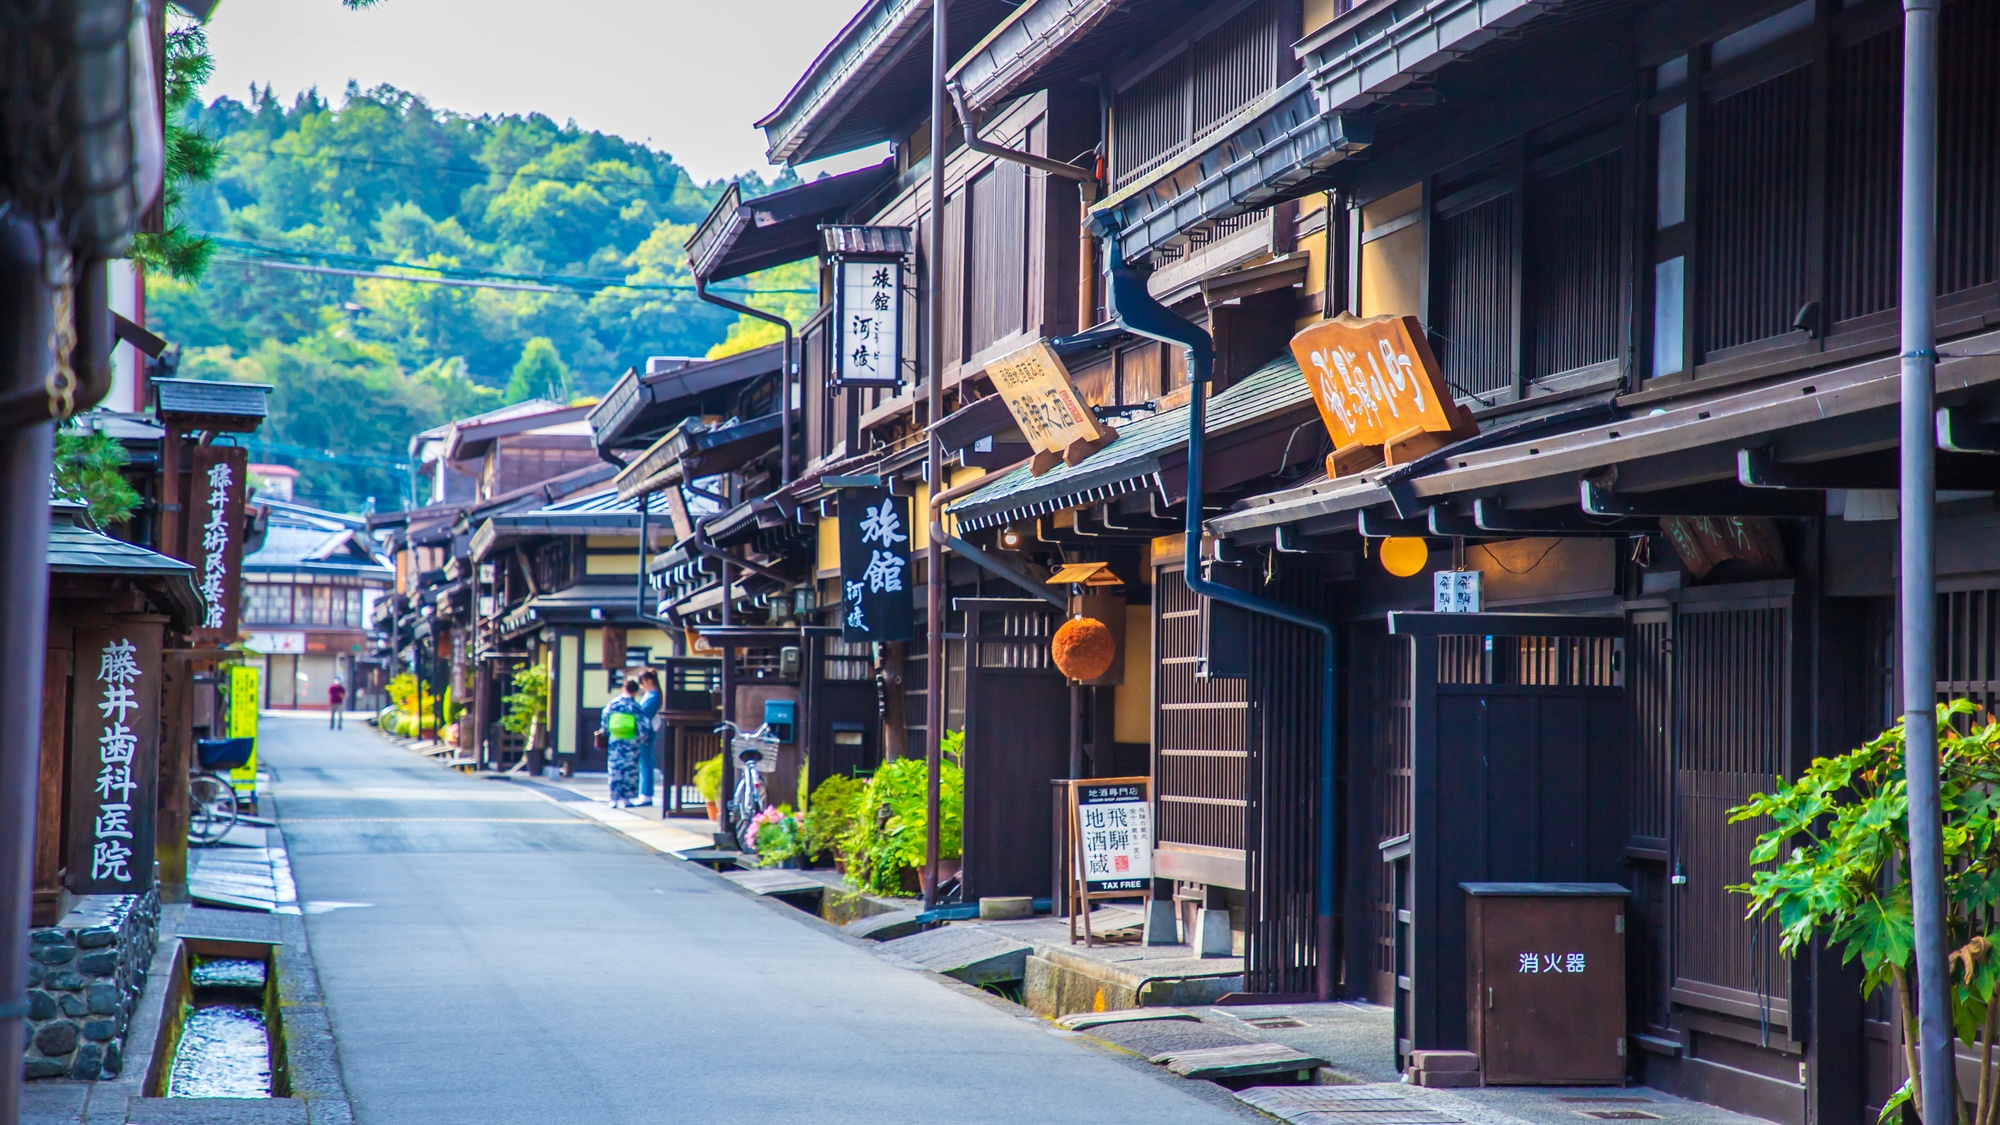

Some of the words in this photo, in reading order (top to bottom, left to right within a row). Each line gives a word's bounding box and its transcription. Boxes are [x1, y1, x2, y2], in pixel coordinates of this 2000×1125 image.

[870, 267, 893, 311] 旅館
[859, 498, 908, 594] 旅館
[91, 638, 142, 882] 藤井歯科医院
[1085, 808, 1109, 874] 地酒蔵
[1107, 807, 1129, 850] 飛騨
[1102, 882, 1118, 890] TAX
[1120, 880, 1142, 889] FREE
[1518, 952, 1586, 974] 消火器
